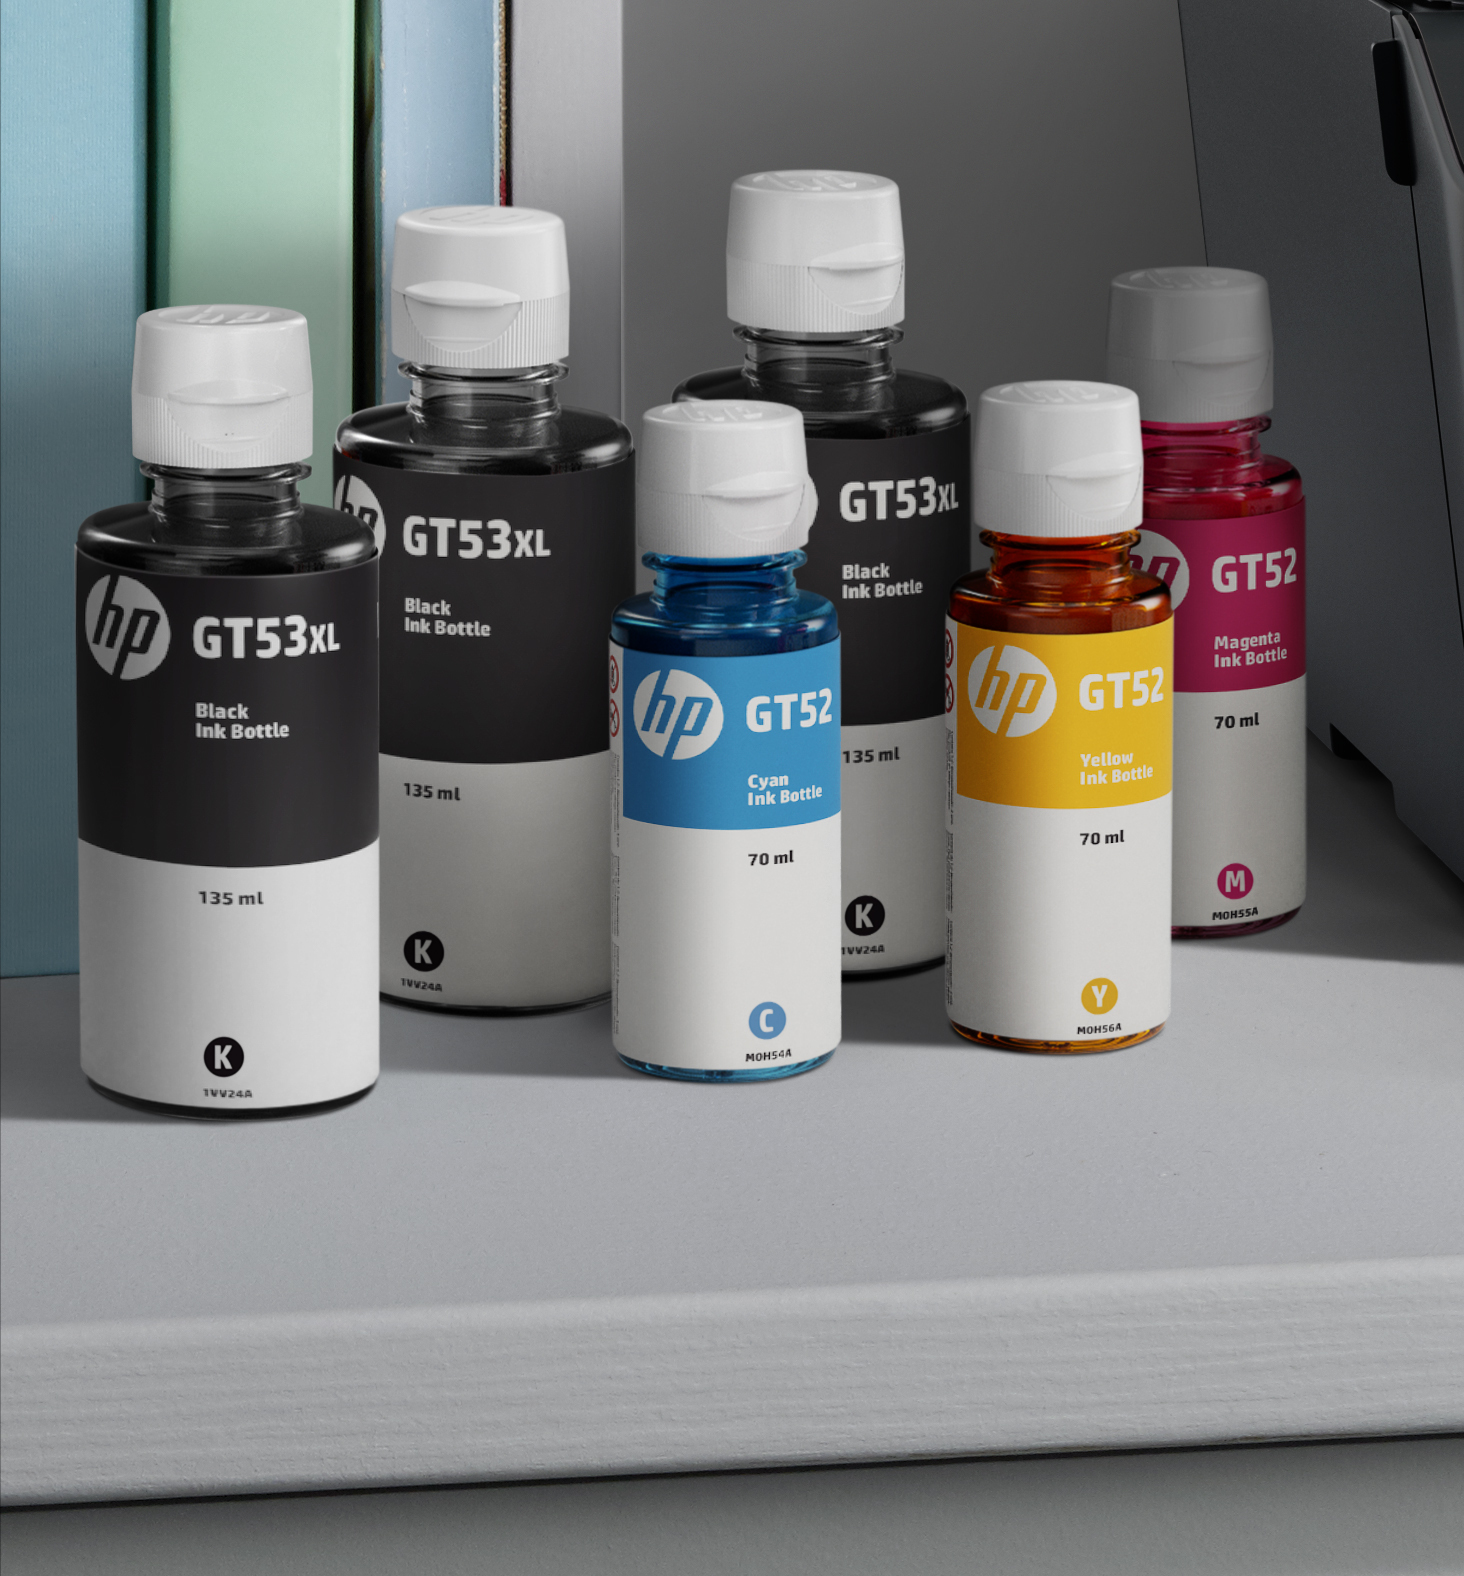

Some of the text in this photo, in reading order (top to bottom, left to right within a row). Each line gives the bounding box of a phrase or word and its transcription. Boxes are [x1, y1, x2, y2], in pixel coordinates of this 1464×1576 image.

[840, 476, 958, 522] GT53XL
[403, 515, 551, 559] GT53XL
[842, 563, 890, 580] Black
[1212, 547, 1297, 593] GT52
[842, 579, 923, 599] Ink Bottle
[405, 597, 451, 616] Black
[90, 575, 163, 679] hp
[193, 614, 341, 659] GT53XL
[405, 617, 491, 637] Ink Bottle
[1214, 631, 1281, 652] Magenta
[1214, 647, 1288, 668] Ink Bottle
[973, 644, 1050, 737] hp
[1079, 666, 1164, 711] GT52
[195, 702, 249, 720] Black
[638, 669, 716, 760] hp
[746, 687, 833, 733] GT52
[1214, 712, 1259, 729] 70 ml
[195, 722, 290, 739] Ink Bottle
[843, 747, 900, 763] 135 ml
[1080, 752, 1134, 768] Yellow
[748, 774, 789, 791] Cyan
[1080, 765, 1154, 785] Ink Bottle
[404, 783, 461, 801] 135 ml
[748, 785, 823, 806] Ink Bottle
[1080, 830, 1125, 845] 70 ml
[748, 850, 794, 866] 70 ml
[1225, 870, 1246, 893] M
[199, 891, 264, 905] 135 ml
[855, 903, 873, 929] K
[414, 939, 433, 964] K
[1091, 984, 1108, 1008] Y
[759, 1008, 774, 1033] C
[214, 1045, 233, 1069] K
